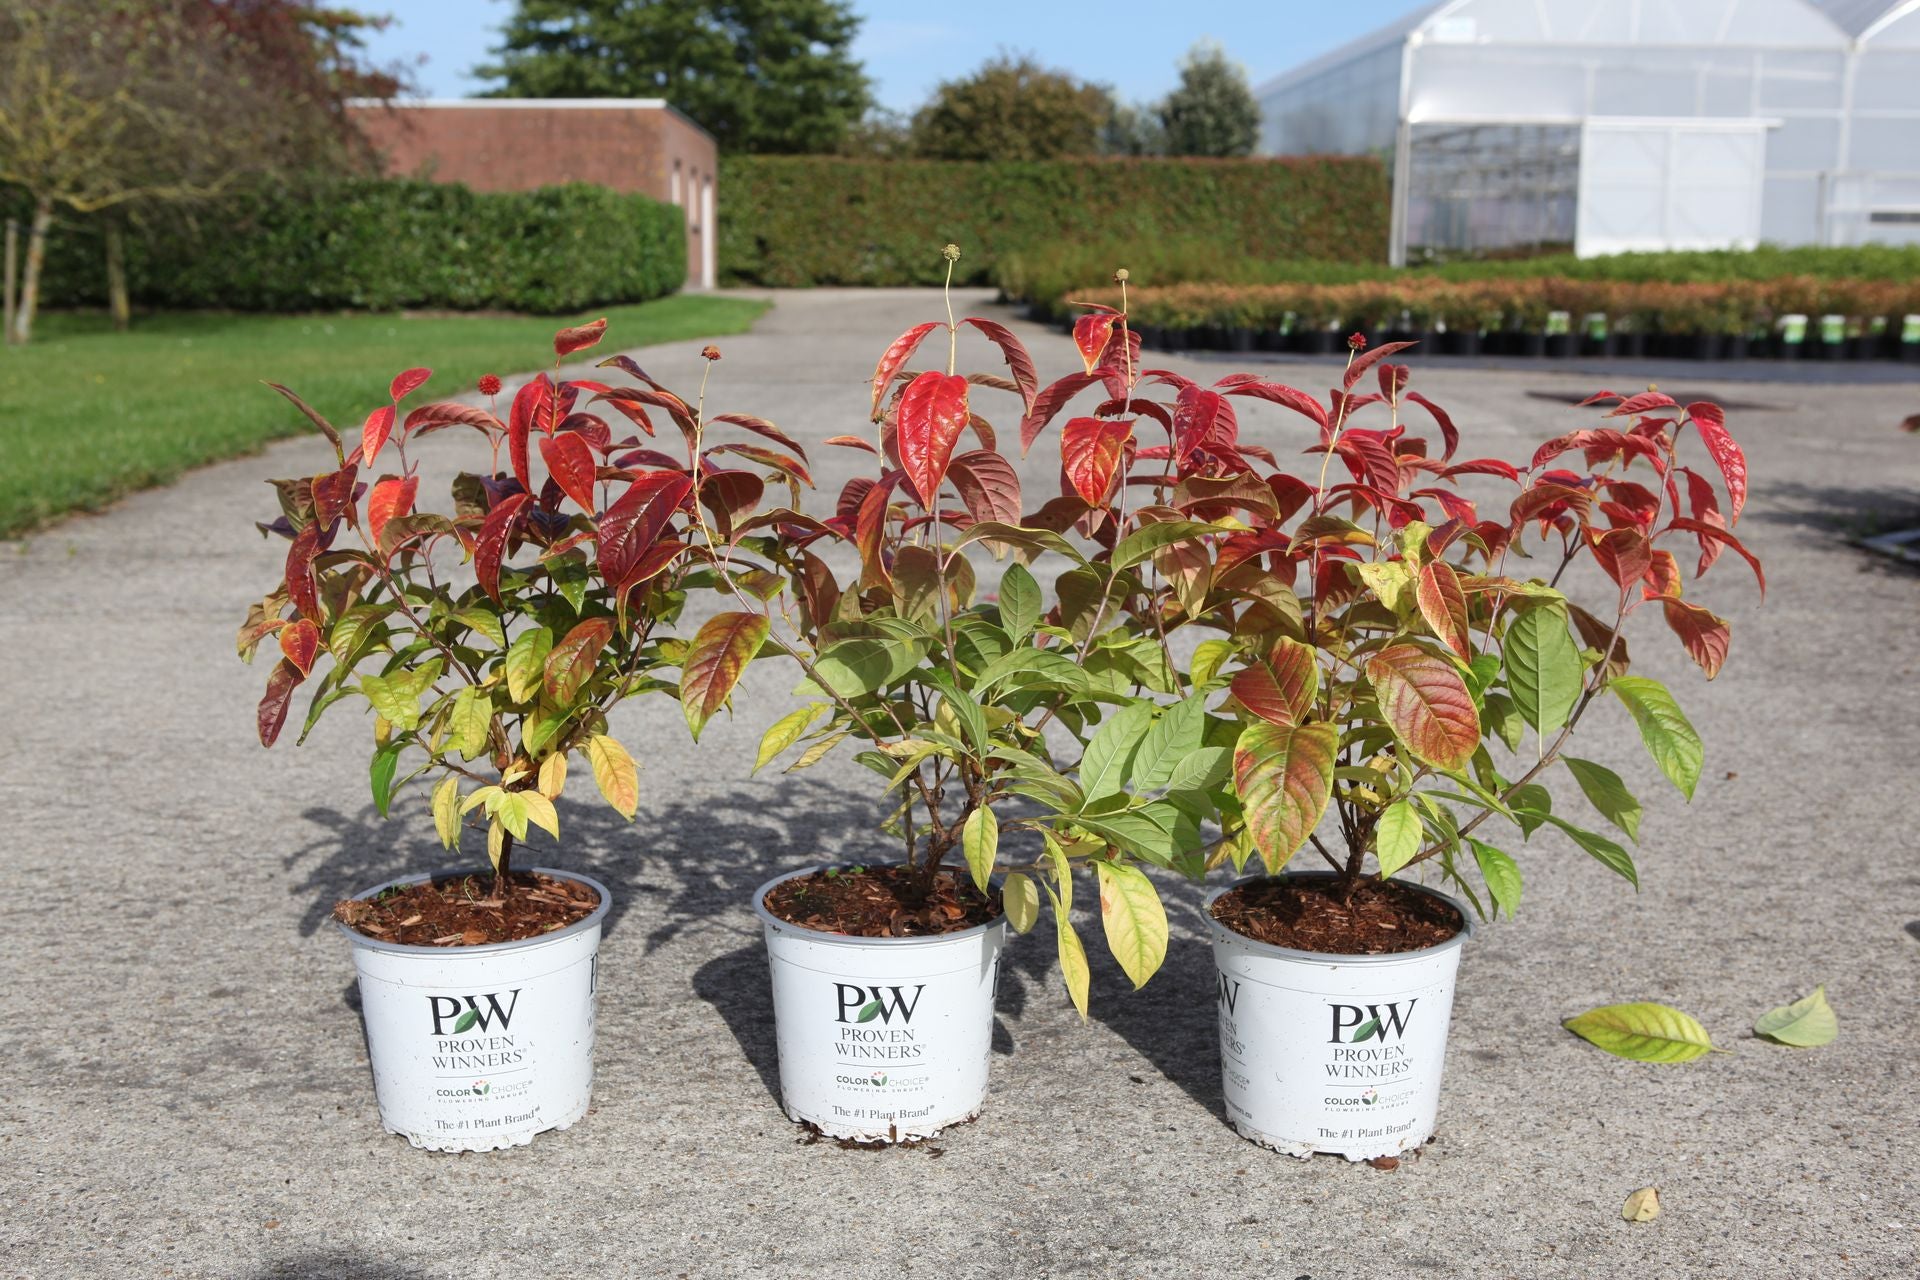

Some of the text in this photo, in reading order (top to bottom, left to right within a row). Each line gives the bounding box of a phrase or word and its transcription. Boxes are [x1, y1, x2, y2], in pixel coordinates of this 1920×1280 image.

[832, 982, 926, 1025] PW
[425, 988, 522, 1035] PW
[1326, 998, 1419, 1044] PW
[841, 1027, 915, 1043] PROVEN
[438, 1035, 515, 1053] PROVEN
[1334, 1044, 1406, 1062] PROVEN
[836, 1075, 925, 1087] COLOR CHOICE
[436, 1082, 528, 1097] COLOR CHOICE
[1324, 1091, 1409, 1106] COLOR CHOICE
[832, 1105, 851, 1117] The
[854, 1108, 866, 1118] #1
[870, 1109, 896, 1120] Plant
[435, 1119, 454, 1130] The
[457, 1119, 470, 1129] #1
[474, 1118, 501, 1129] Plant
[1317, 1127, 1338, 1138] The
[1341, 1129, 1354, 1138] #1
[1358, 1128, 1383, 1138] Plant
